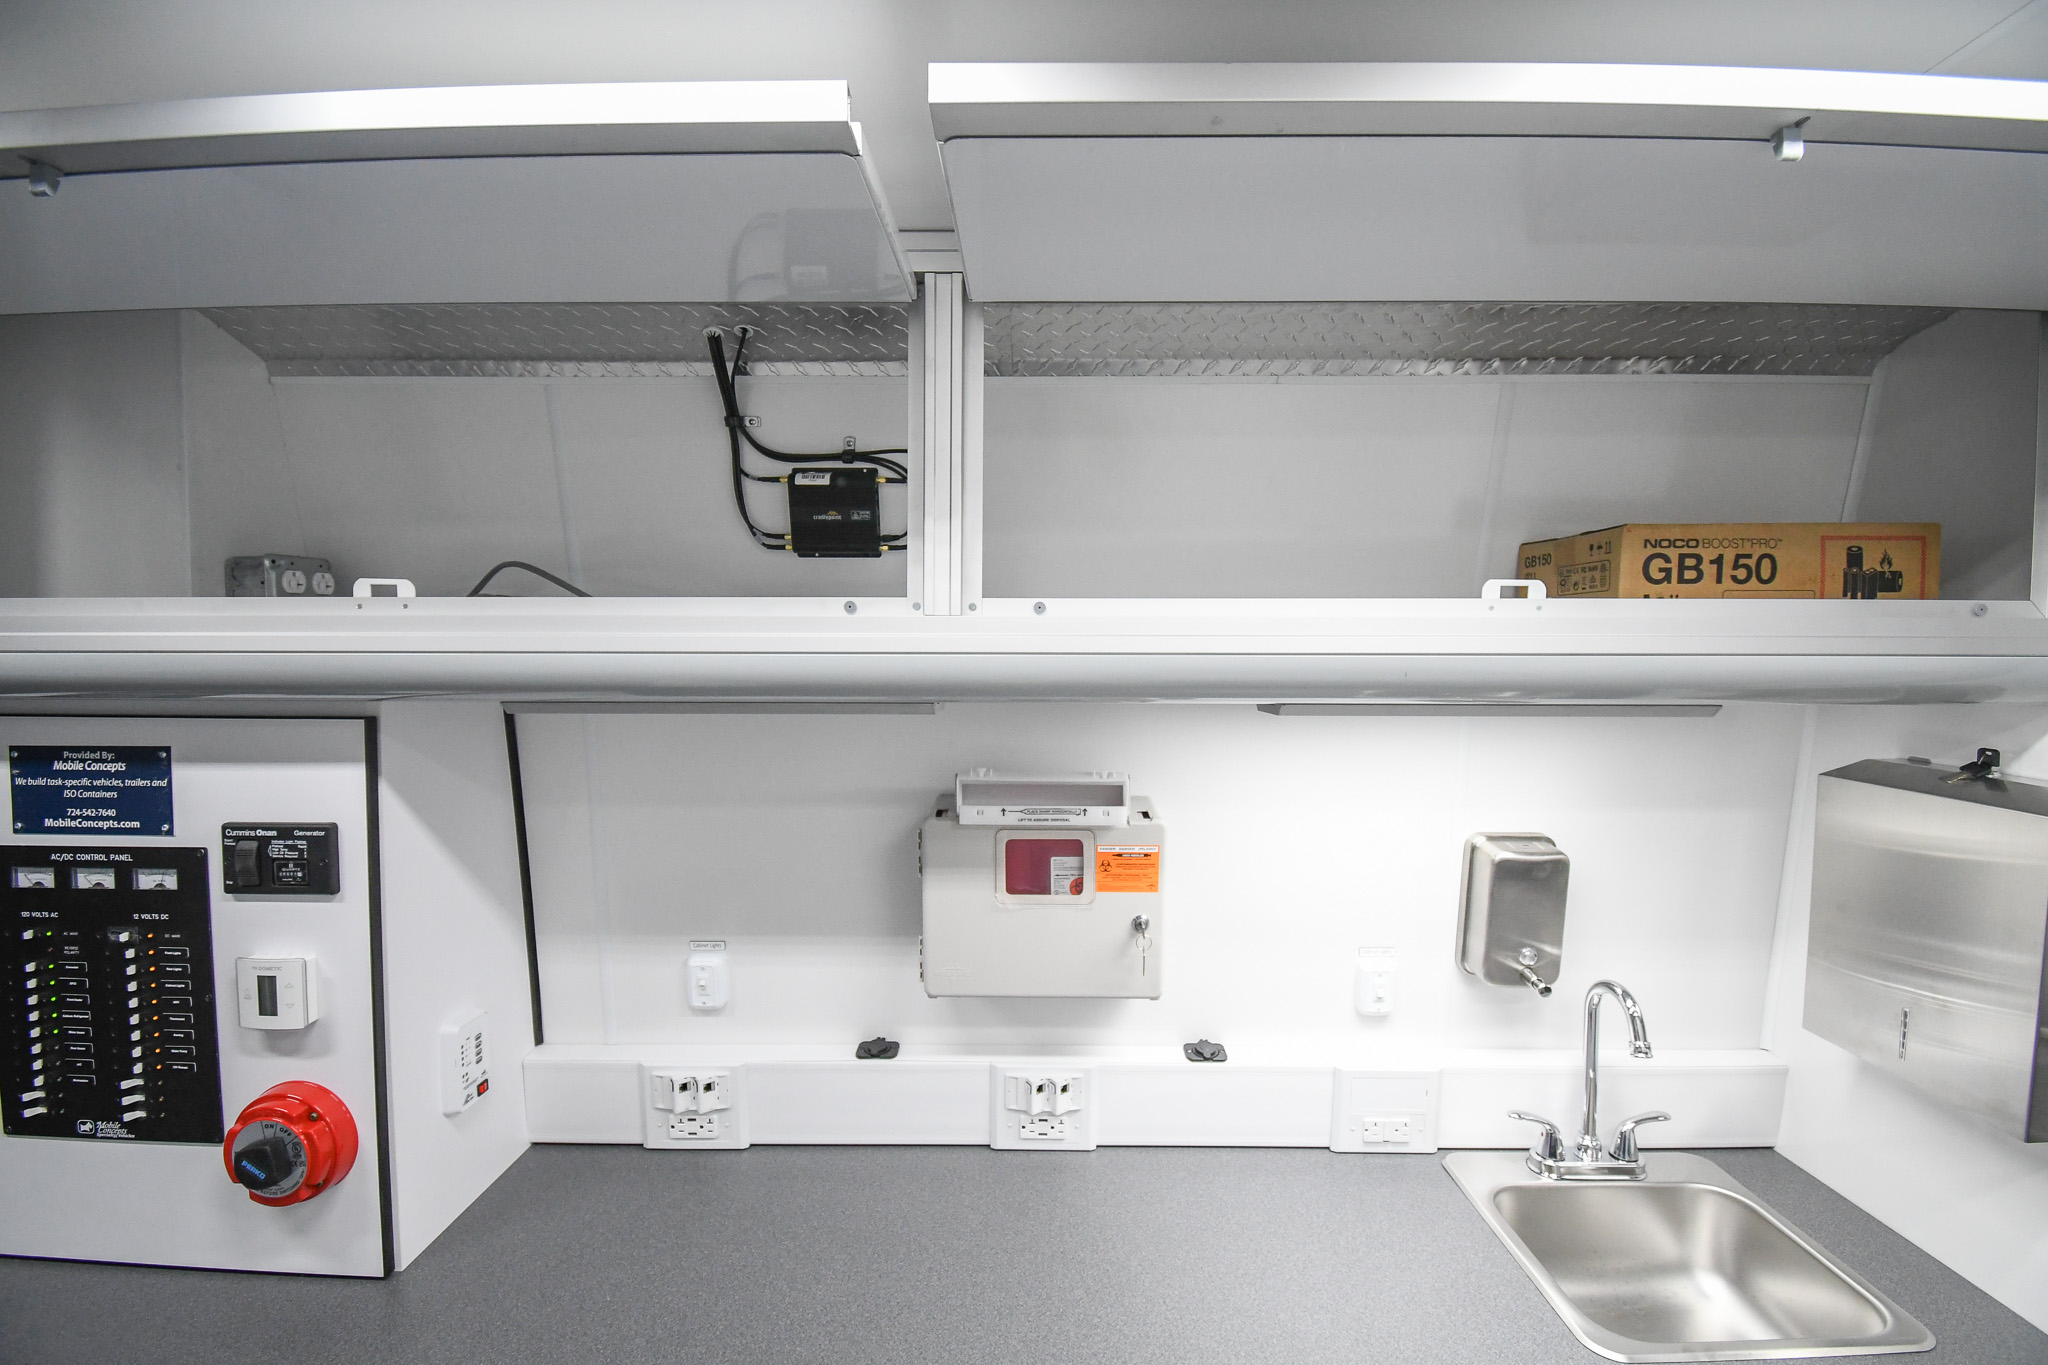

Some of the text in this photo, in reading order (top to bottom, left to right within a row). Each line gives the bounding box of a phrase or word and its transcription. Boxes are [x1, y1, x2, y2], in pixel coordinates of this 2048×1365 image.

[1644, 538, 1700, 549] NOCO
[1524, 553, 1552, 568] GB150
[1642, 552, 1778, 585] GB150
[102, 751, 115, 760] By:
[53, 760, 126, 773] Mobile Concepts
[15, 777, 168, 788] We build task-specific vehicles, trailers and
[78, 790, 118, 798] Containers
[66, 808, 116, 816] 724-542-7640
[44, 818, 140, 829] MobileConcepts.com
[97, 1121, 121, 1129] Mobile
[280, 1127, 292, 1137] OFF
[241, 1160, 266, 1180] PERKO
